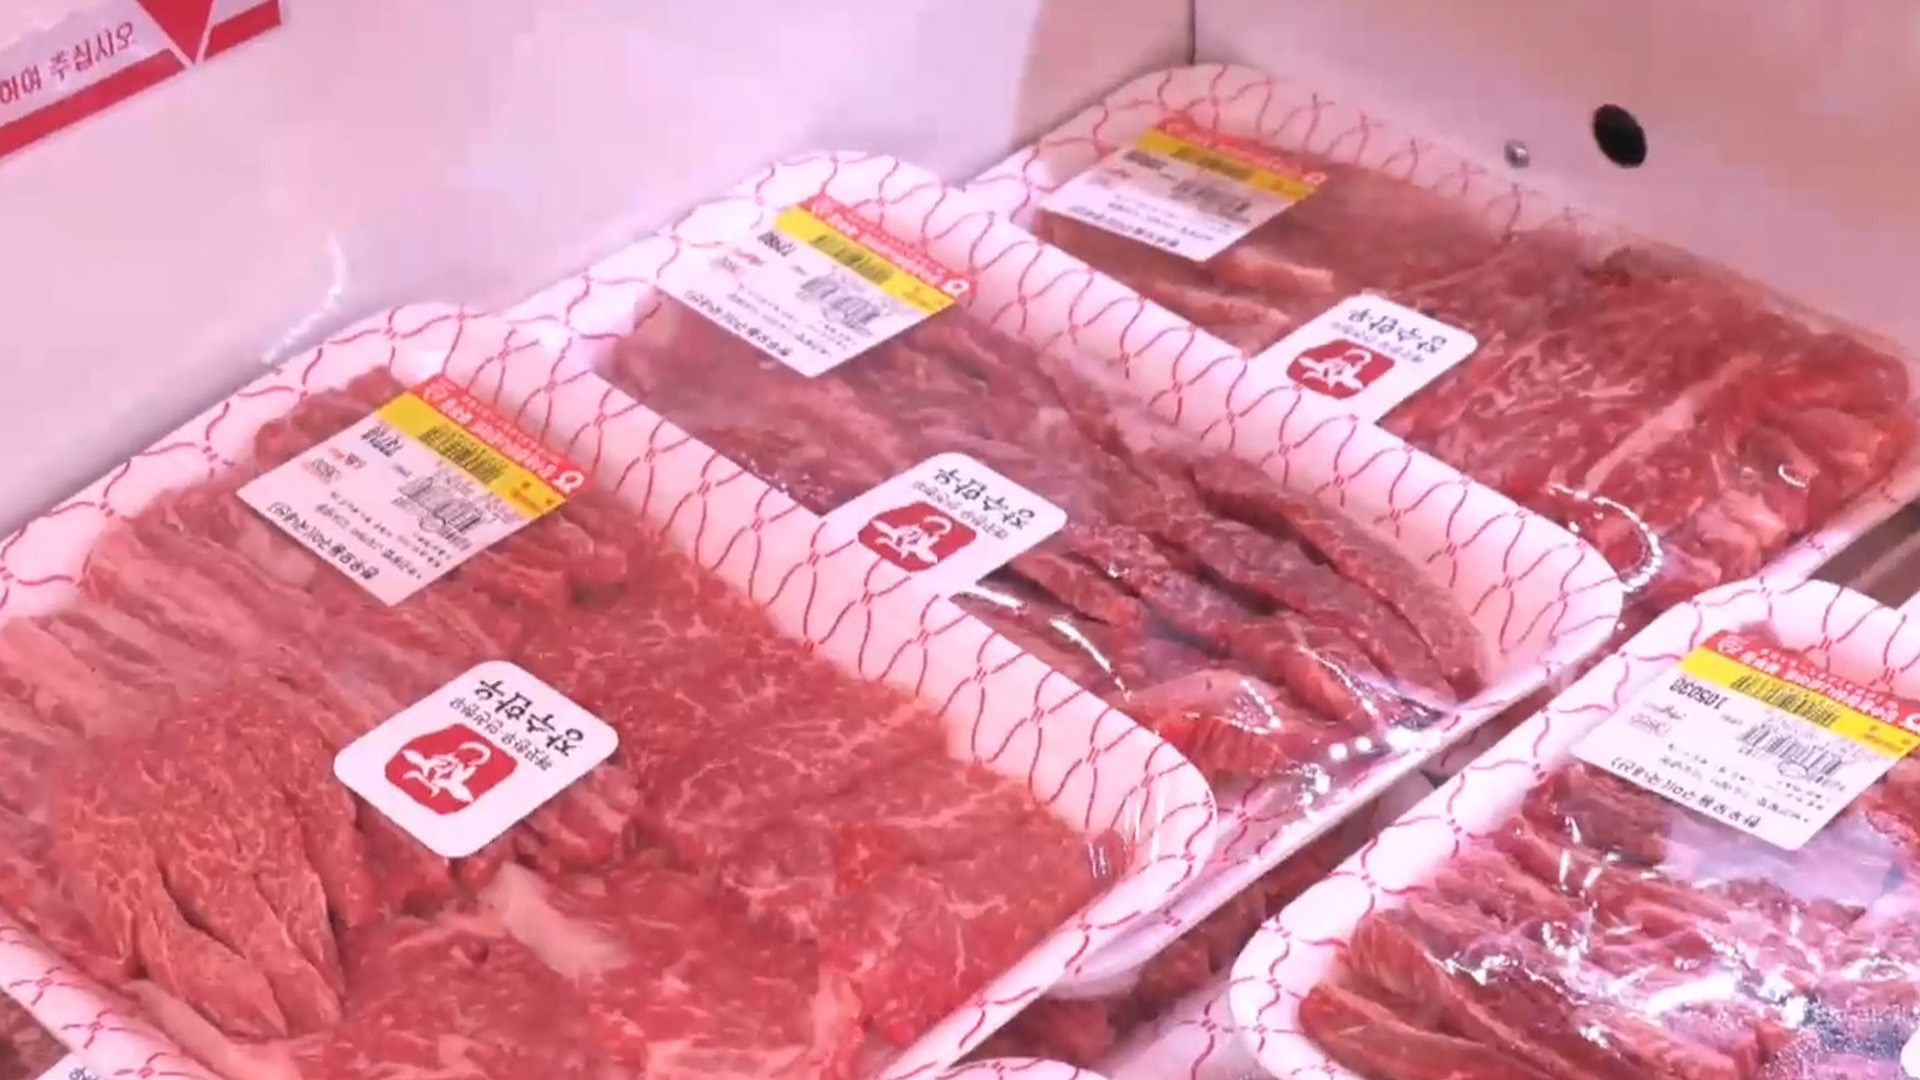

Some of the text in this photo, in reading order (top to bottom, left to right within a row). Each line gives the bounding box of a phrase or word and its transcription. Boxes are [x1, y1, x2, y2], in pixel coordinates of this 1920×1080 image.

[50, 22, 133, 81] 주십시오
[934, 469, 1035, 530] 장수한우
[474, 680, 584, 757] 장수한우
